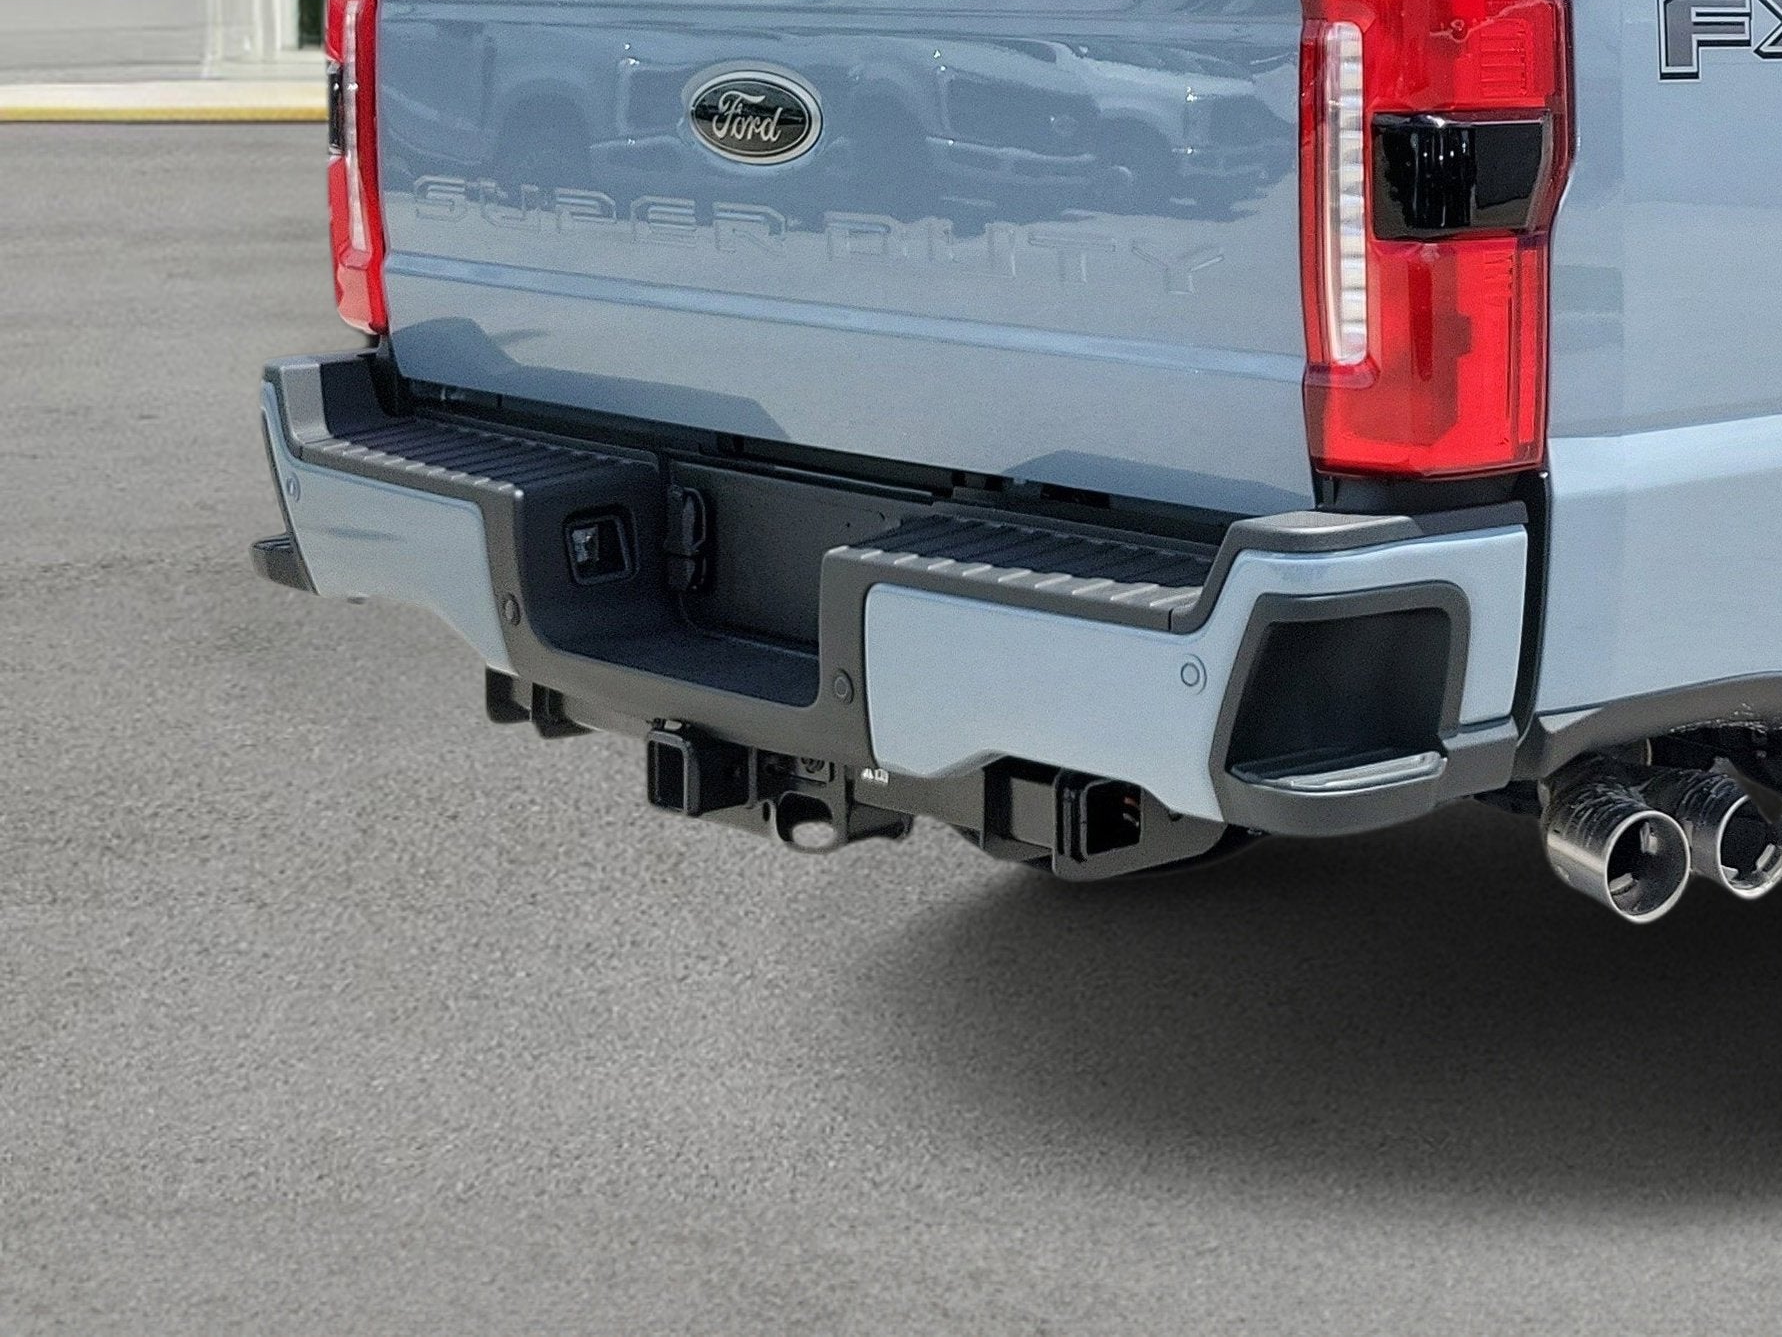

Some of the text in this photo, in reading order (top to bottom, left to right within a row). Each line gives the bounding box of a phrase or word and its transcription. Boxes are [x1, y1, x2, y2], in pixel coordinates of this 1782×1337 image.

[712, 90, 784, 142] Ford
[413, 175, 1226, 296] SUPER DUTY
